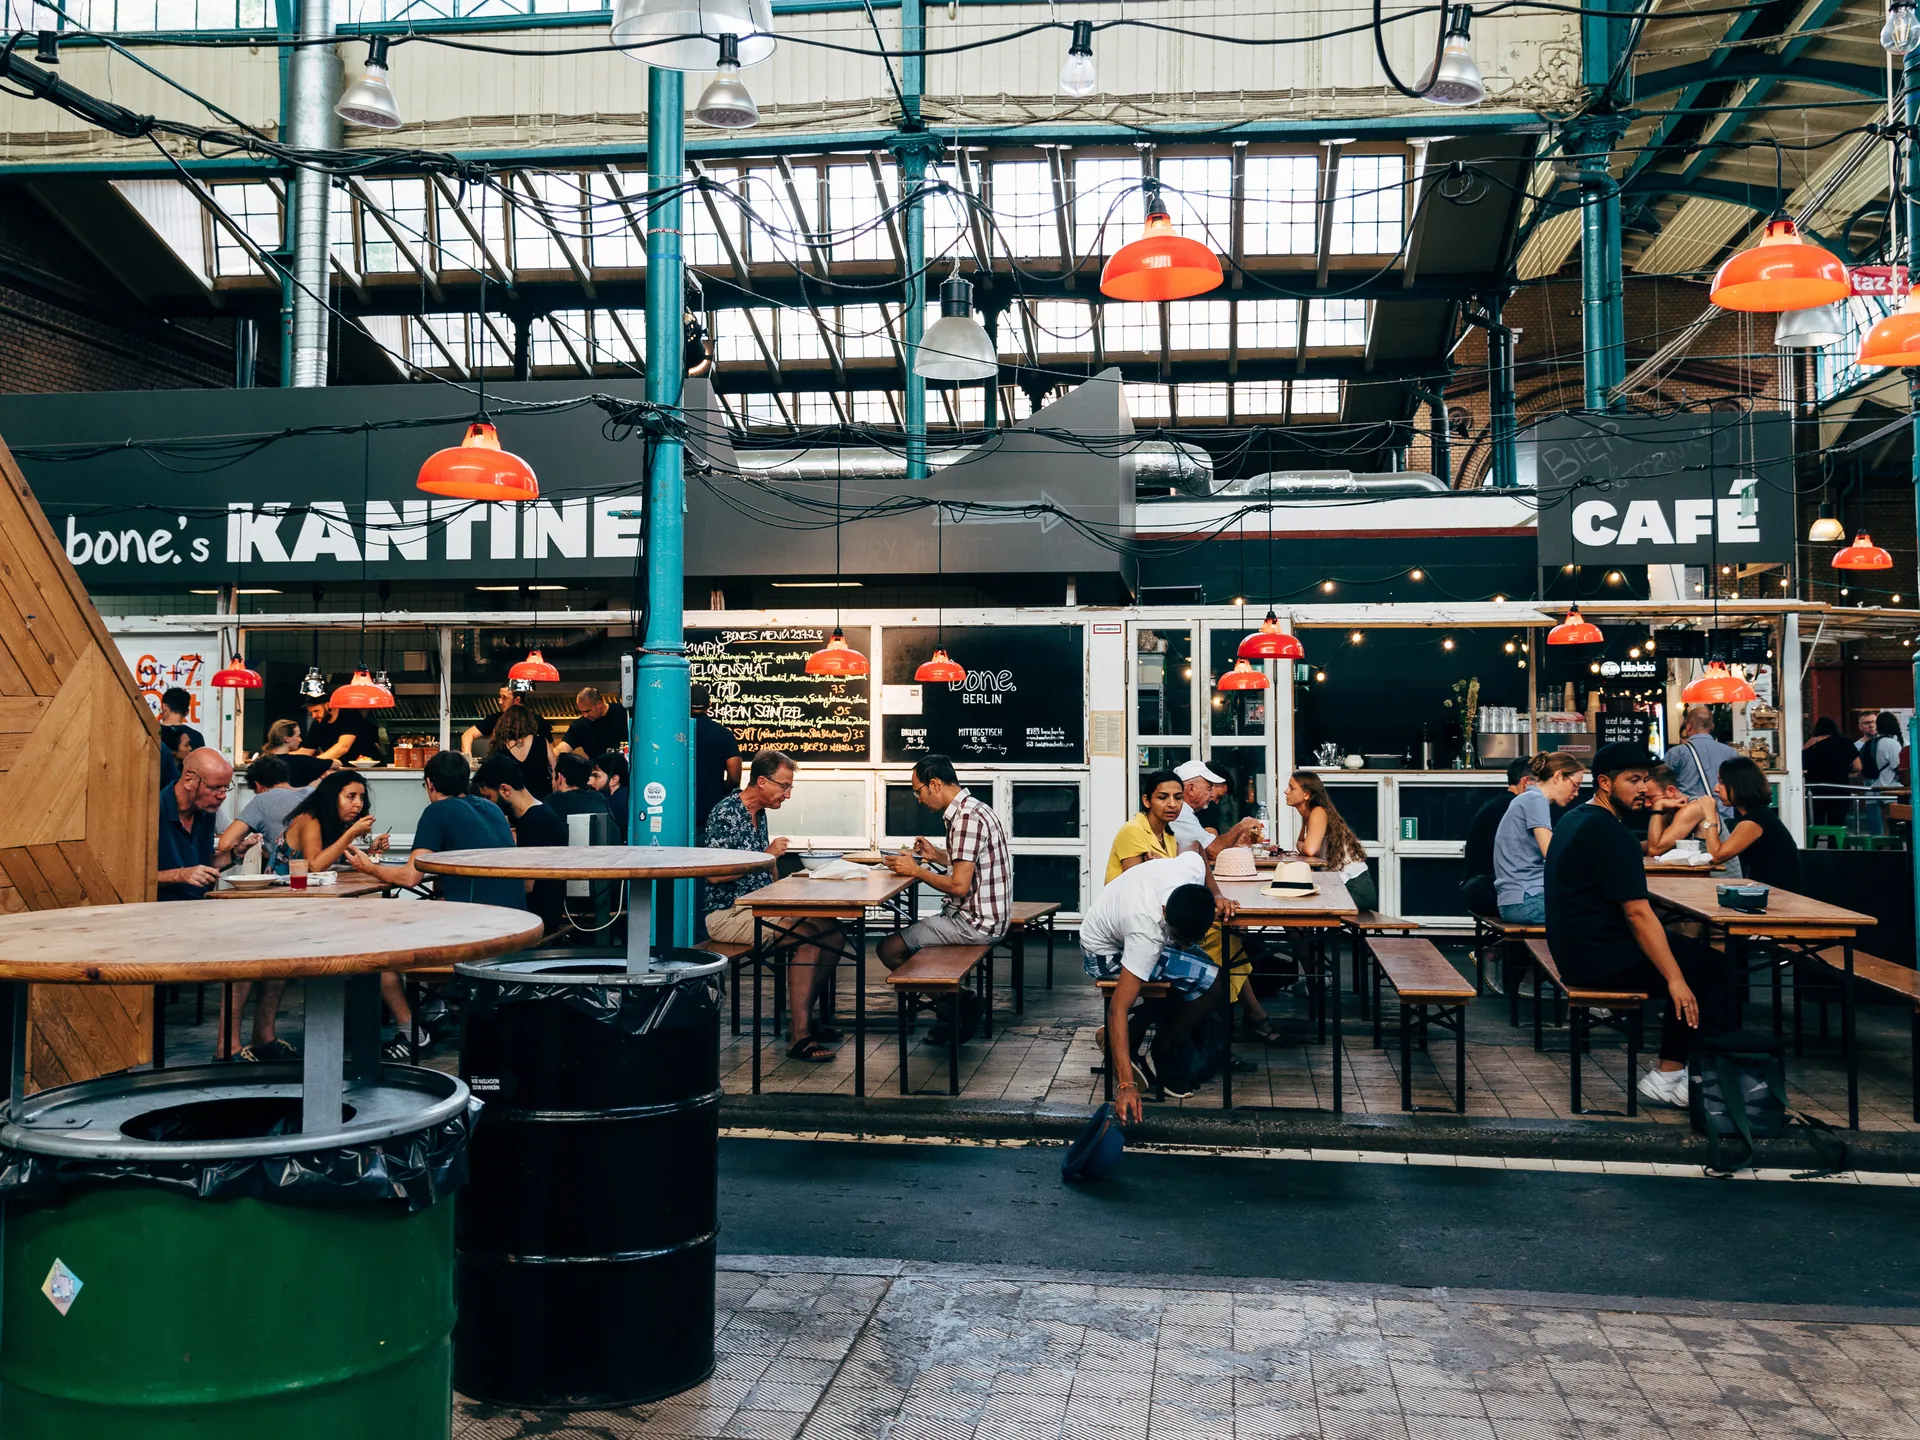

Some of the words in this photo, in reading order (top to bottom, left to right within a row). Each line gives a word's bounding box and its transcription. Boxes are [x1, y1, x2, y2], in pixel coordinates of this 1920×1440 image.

[1851, 274, 1886, 291] taz
[1541, 420, 1632, 484] BIER
[1572, 478, 1760, 546] CAFÉ
[226, 496, 642, 563] KANTINE
[962, 694, 1002, 704] BERLIN
[1605, 717, 1618, 725] iced
[901, 728, 927, 736] BRUNCH
[958, 728, 1002, 736] MITTAGSTISCH
[1605, 734, 1616, 742] iced
[1617, 734, 1631, 742] filter
